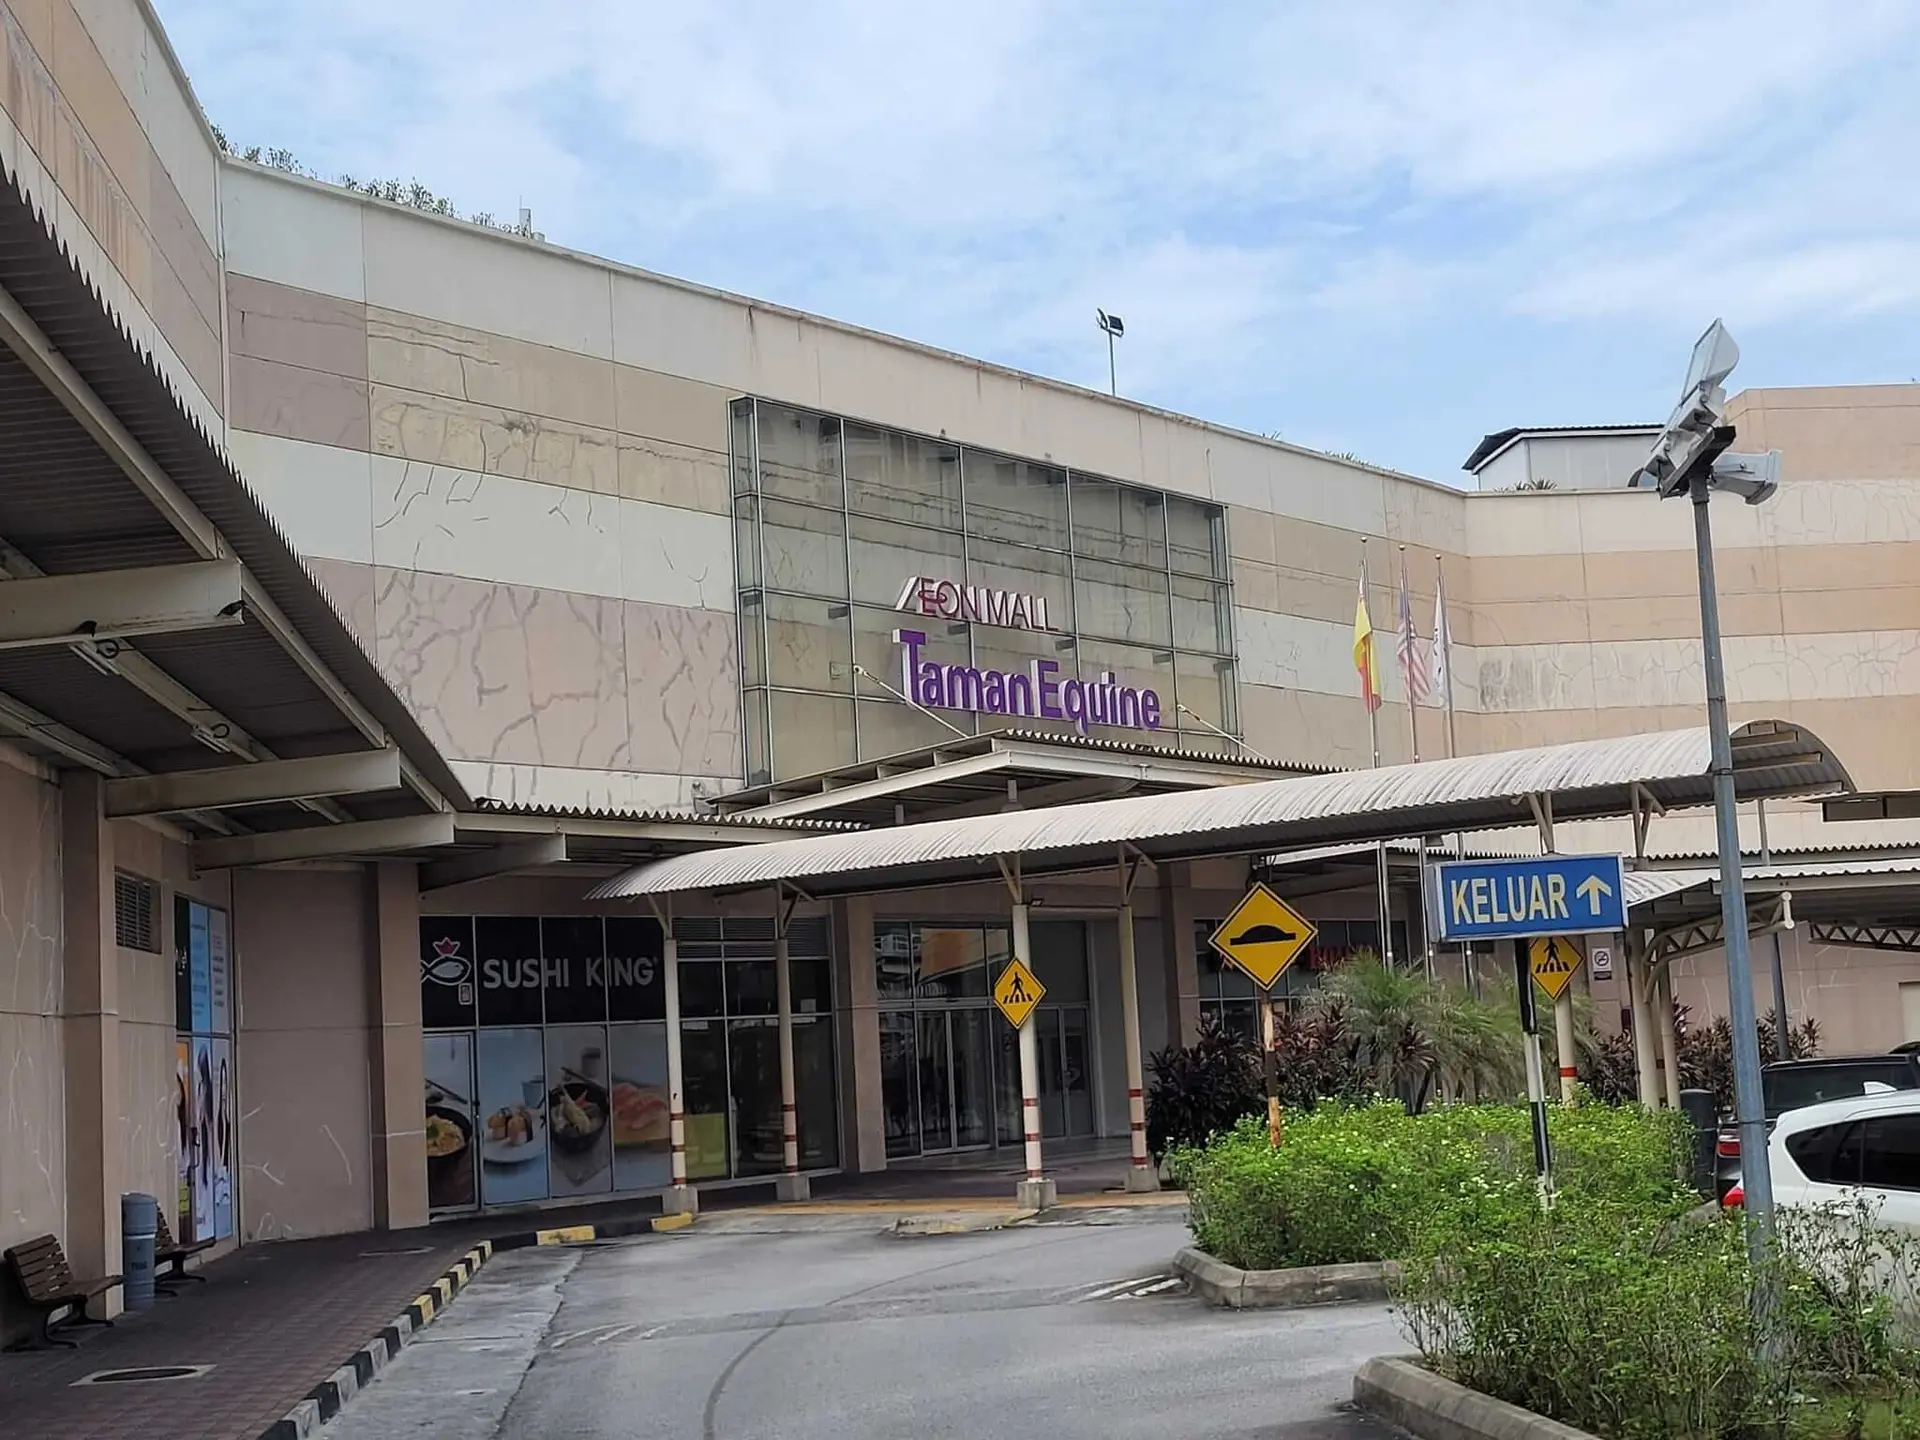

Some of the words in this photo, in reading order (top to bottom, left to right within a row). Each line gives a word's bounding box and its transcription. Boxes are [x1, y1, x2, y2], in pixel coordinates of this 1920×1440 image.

[981, 588, 1058, 631] MALL
[893, 628, 1032, 716] Taman
[1031, 659, 1161, 735] Equine
[1451, 873, 1569, 925] KELUAR
[483, 957, 569, 988] SUSHI
[585, 957, 654, 987] KING
